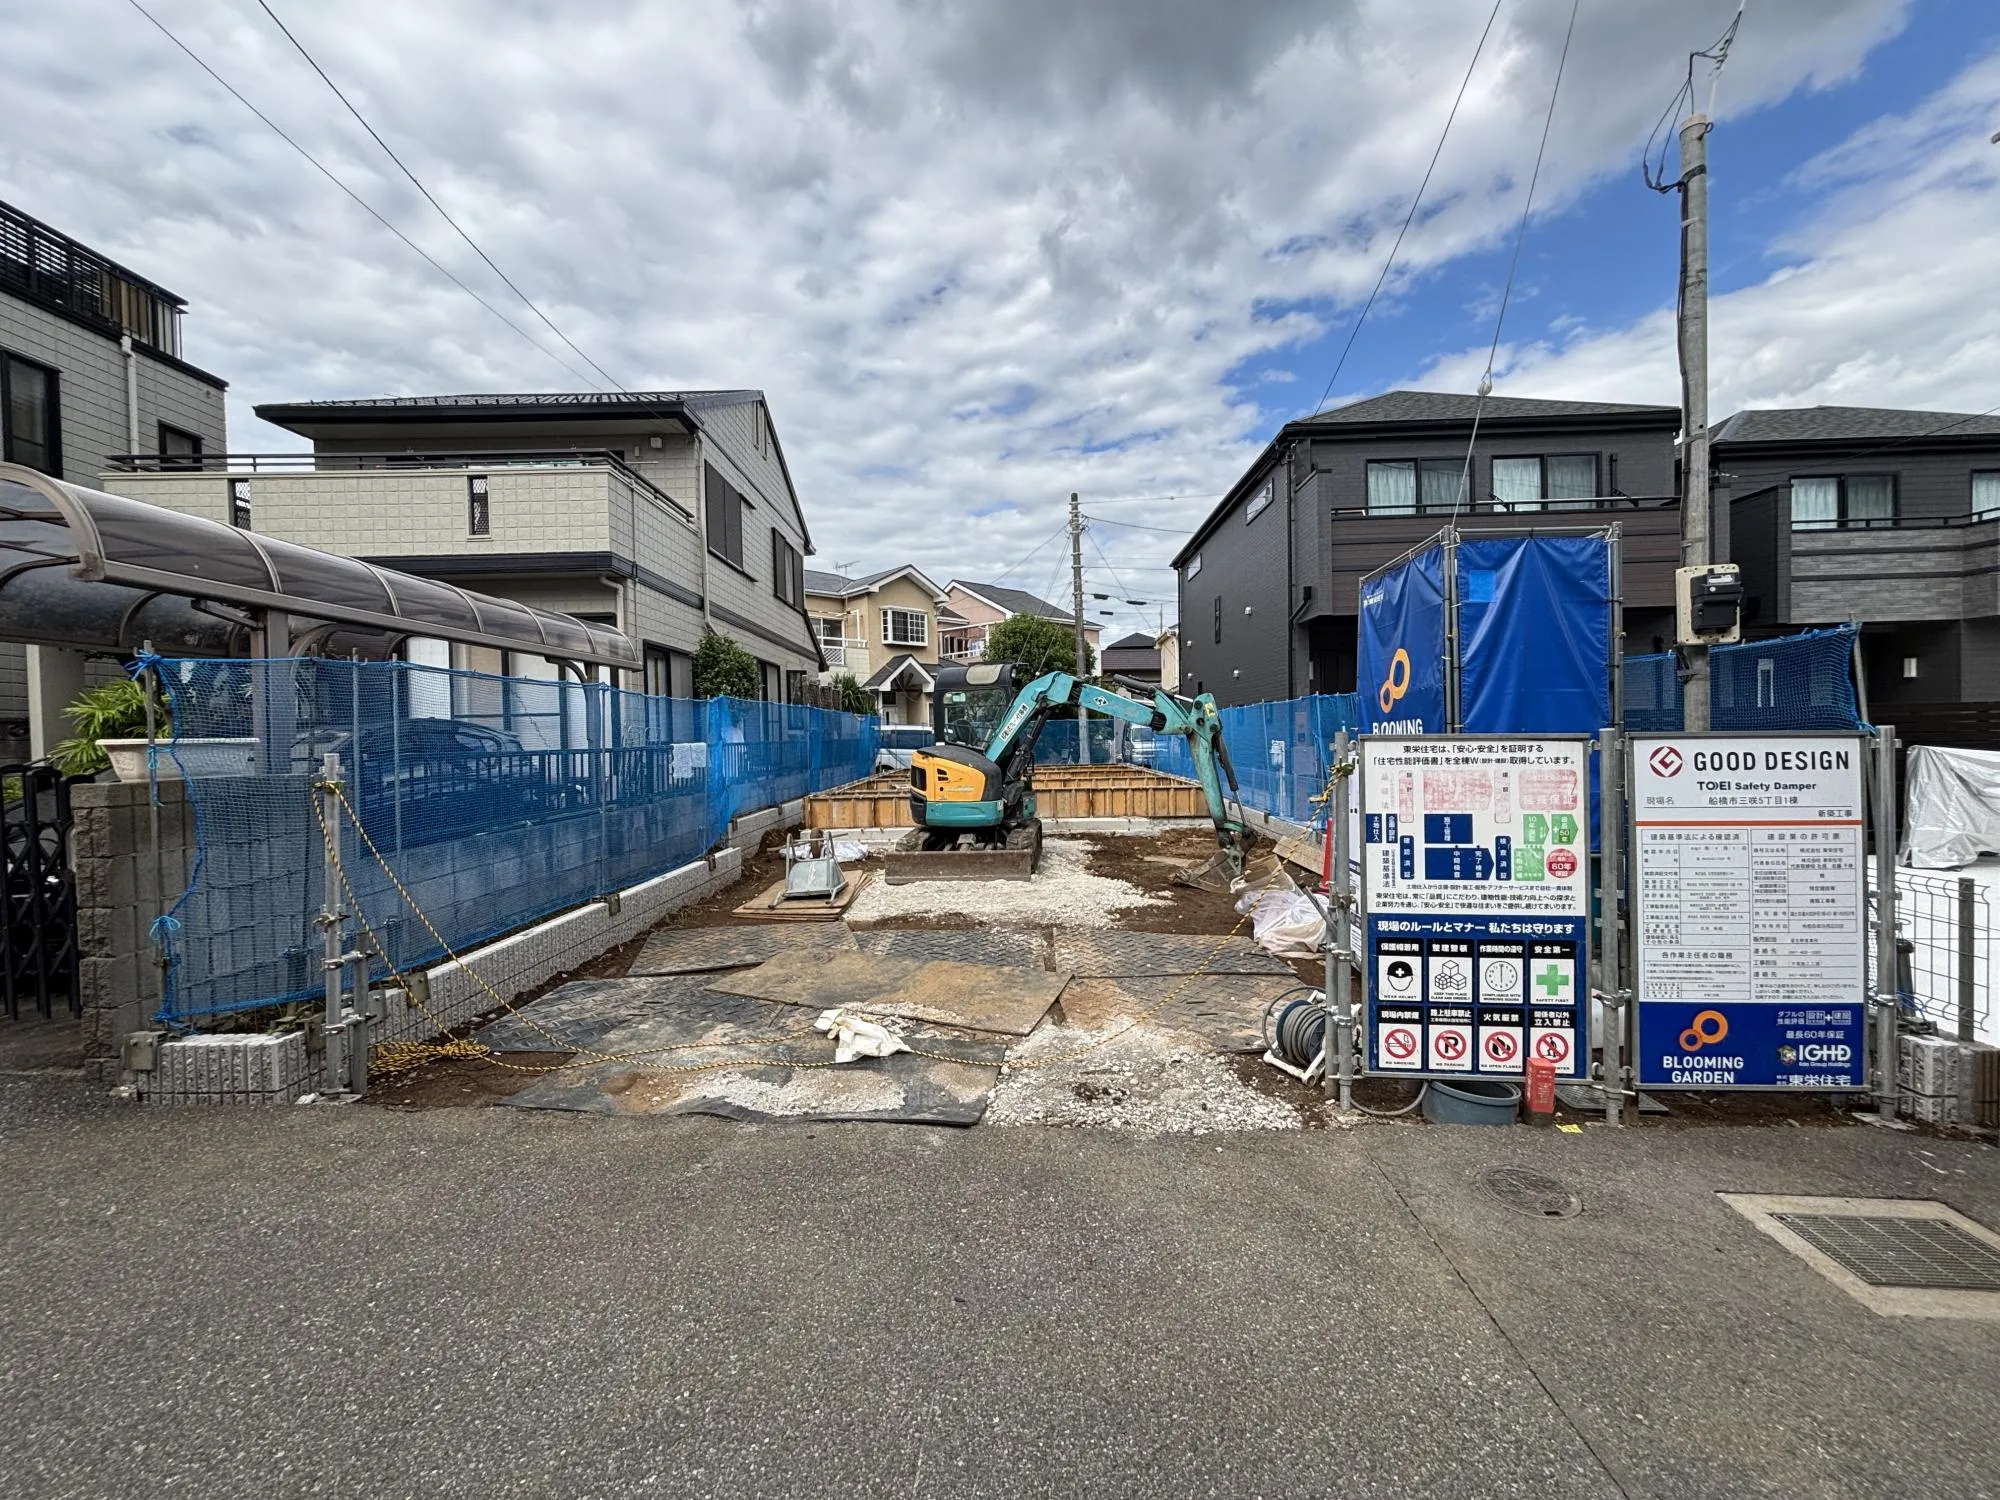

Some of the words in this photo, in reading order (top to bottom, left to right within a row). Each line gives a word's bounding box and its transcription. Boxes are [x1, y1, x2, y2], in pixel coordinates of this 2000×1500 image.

[1693, 751, 1756, 771] GOOD
[1764, 750, 1849, 771] DESIGN
[1735, 782, 1770, 792] Safety
[1774, 782, 1816, 792] Damper
[1646, 796, 1674, 805] 現場名
[1709, 795, 1798, 806] 船橋市三咲5丁目1棟
[1818, 809, 1852, 818] 新築工事
[1650, 833, 1740, 841] 建築基準法による確認済
[1767, 832, 1840, 841] 建設業の許可票
[1382, 849, 1390, 888] 建築基準法
[1377, 921, 1486, 933] 現場のルールとマナー
[1488, 922, 1575, 934] 私たちは守ります
[1381, 943, 1419, 952] 保護帽着用
[1432, 944, 1468, 953] 整理整頓
[1534, 945, 1571, 954] 安全第一
[1483, 1013, 1519, 1022] 火気厳禁
[1534, 1011, 1570, 1019] 関係者以外
[1808, 1012, 1823, 1020] 設計
[1534, 1018, 1570, 1027] 立入禁止
[1786, 1030, 1845, 1039] 最長60年保証
[1798, 1044, 1852, 1061] IGHD
[1662, 1055, 1744, 1069] BLOOMING
[1671, 1070, 1735, 1084] GARDEN
[1789, 1074, 1852, 1086] 東栄住宅
